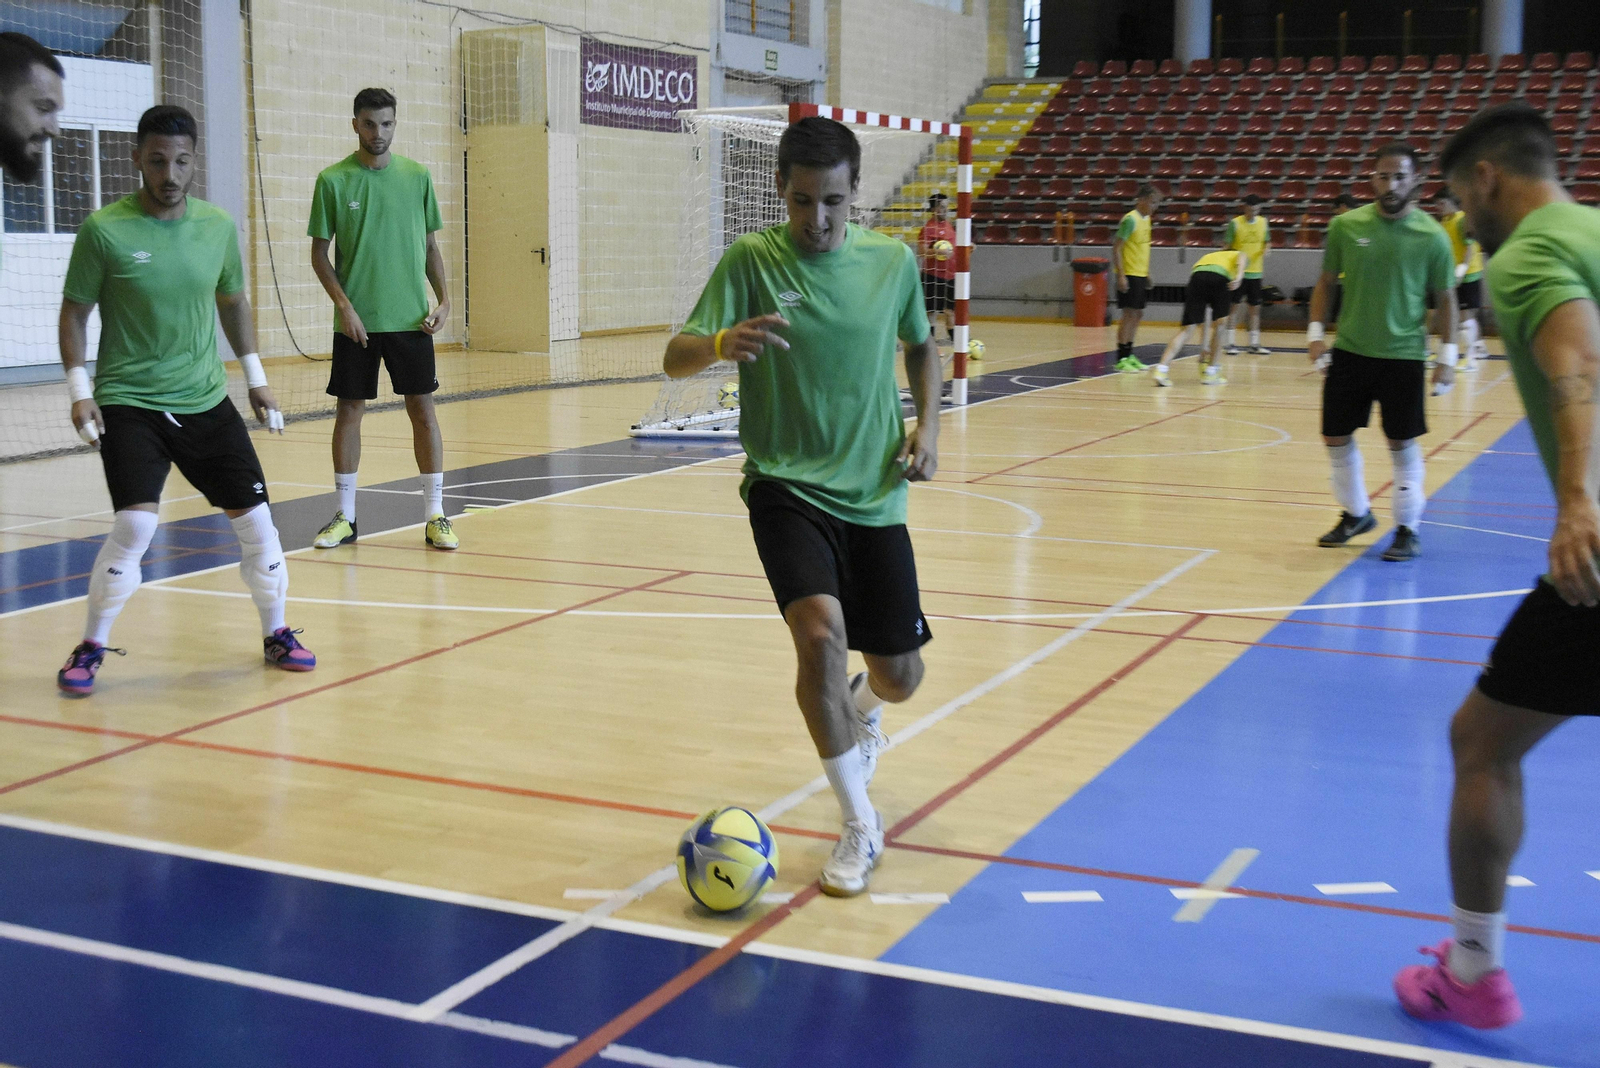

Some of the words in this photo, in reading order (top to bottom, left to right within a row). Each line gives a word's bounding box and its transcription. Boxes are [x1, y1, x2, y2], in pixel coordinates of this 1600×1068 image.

[613, 63, 693, 103] IMDECO
[586, 100, 611, 112] Instituto
[612, 104, 639, 117] Municipal
[639, 107, 646, 117] de
[647, 108, 671, 119] Deportes
